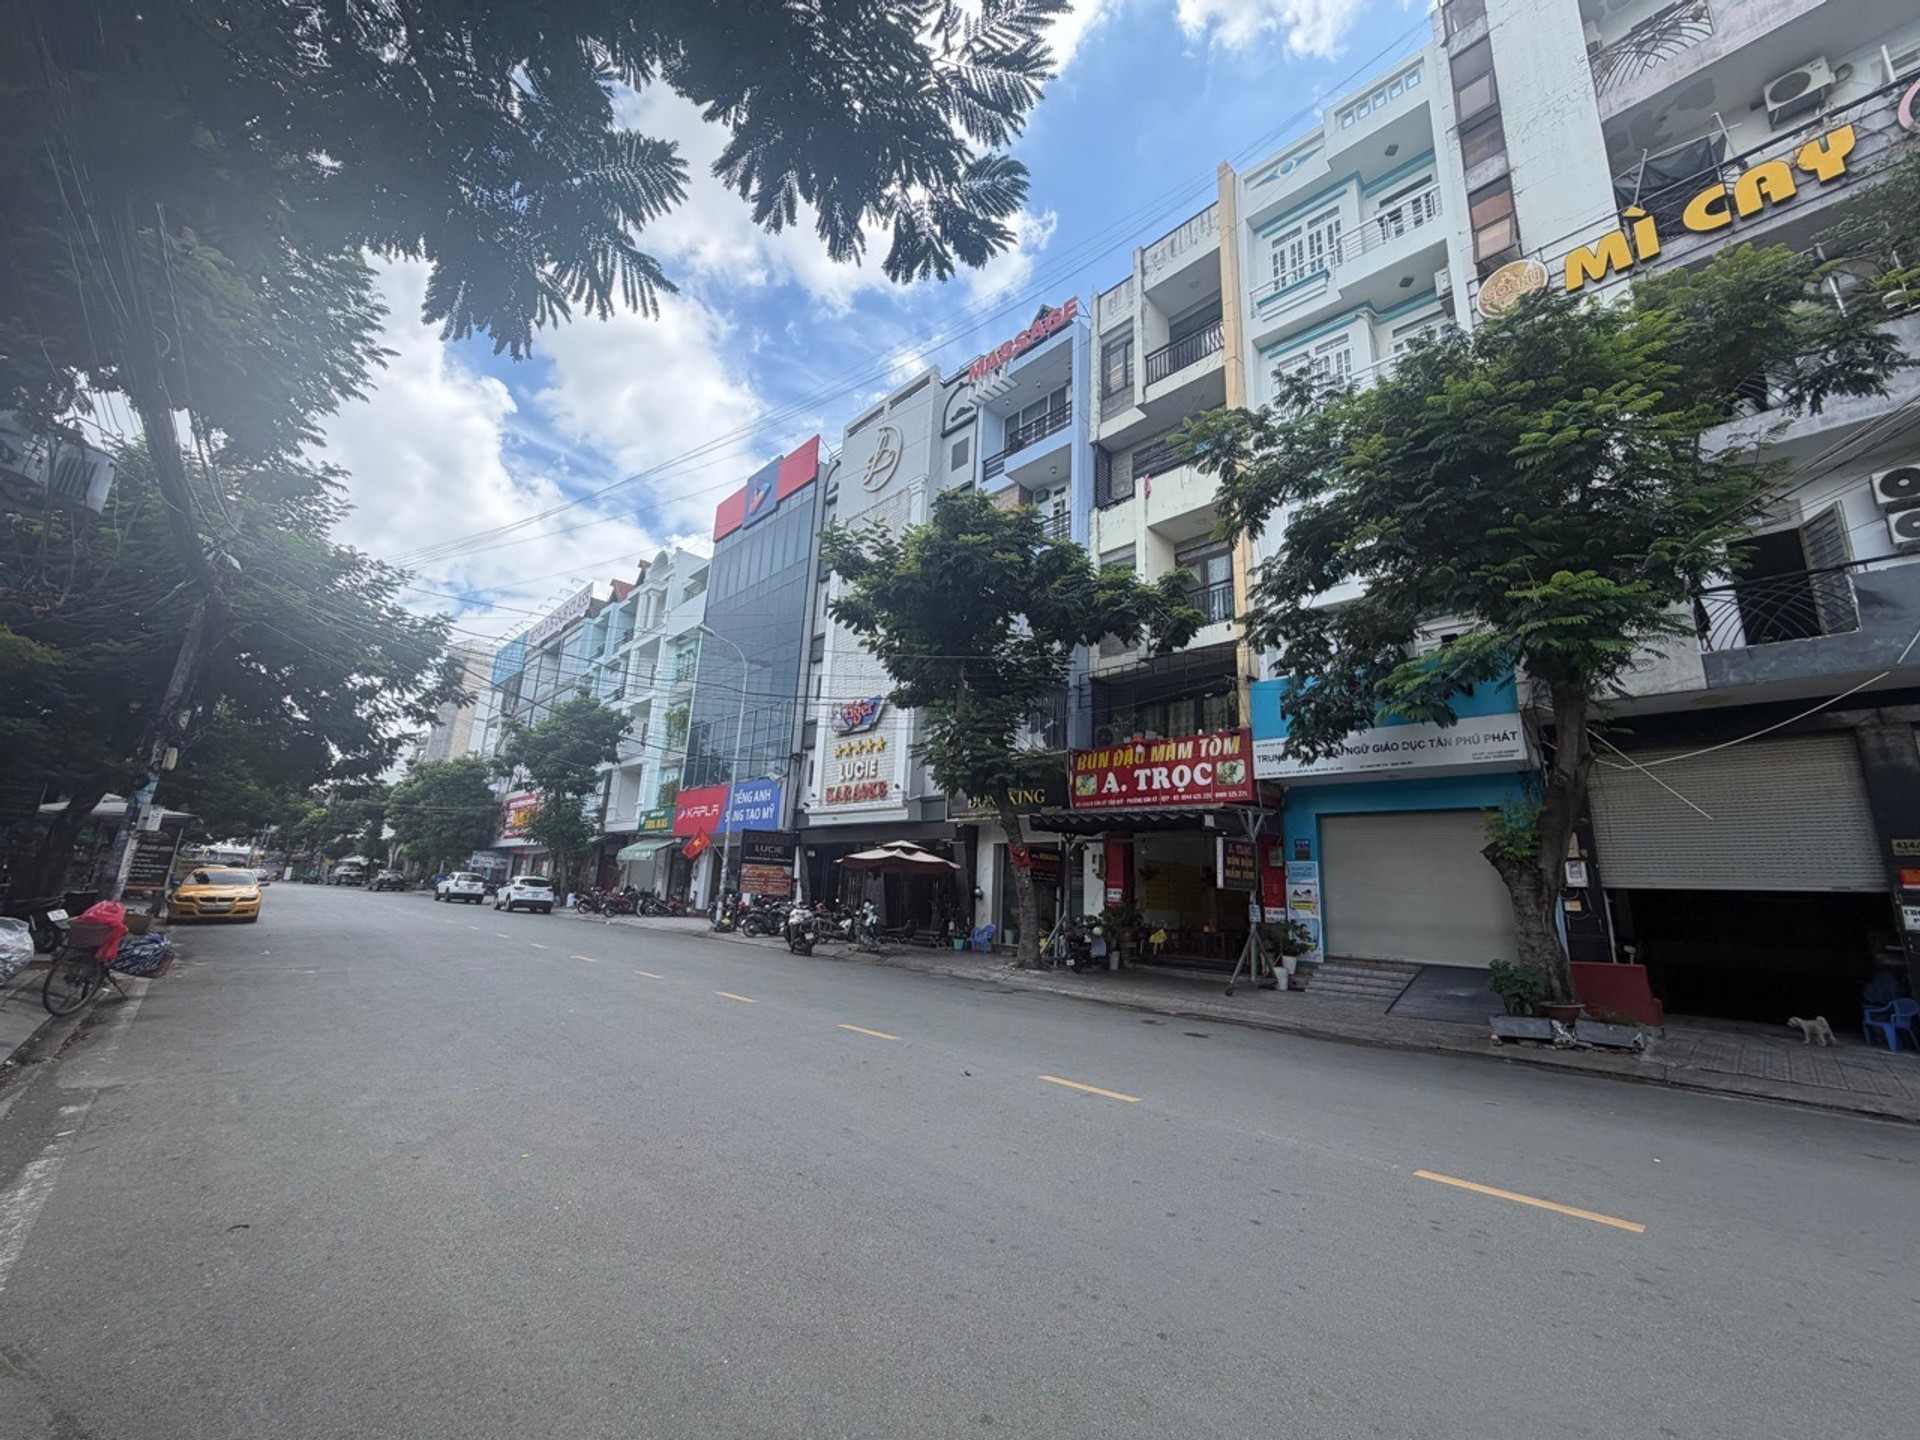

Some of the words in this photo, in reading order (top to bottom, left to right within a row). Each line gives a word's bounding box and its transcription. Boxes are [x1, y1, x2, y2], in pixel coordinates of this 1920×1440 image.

[1566, 205, 1660, 292] MÌ
[1682, 124, 1856, 232] CAY
[968, 295, 1079, 384] MASSAGE
[1077, 750, 1110, 771] BÚN
[1150, 737, 1193, 762] MẮM
[1200, 734, 1241, 758] TÔM
[1373, 740, 1399, 753] GIÁO
[1429, 737, 1452, 749] TÂN
[1484, 729, 1518, 743] PHÁT
[838, 759, 878, 780] LUCIE
[1101, 772, 1127, 793] A.
[1133, 762, 1213, 792] TRỌC
[753, 789, 773, 802] ANH
[825, 780, 888, 803] KARAOKE
[724, 808, 745, 823] SNG
[745, 807, 761, 825] TẠO
[762, 802, 776, 820] MỸ
[754, 844, 785, 855] LUCIE
